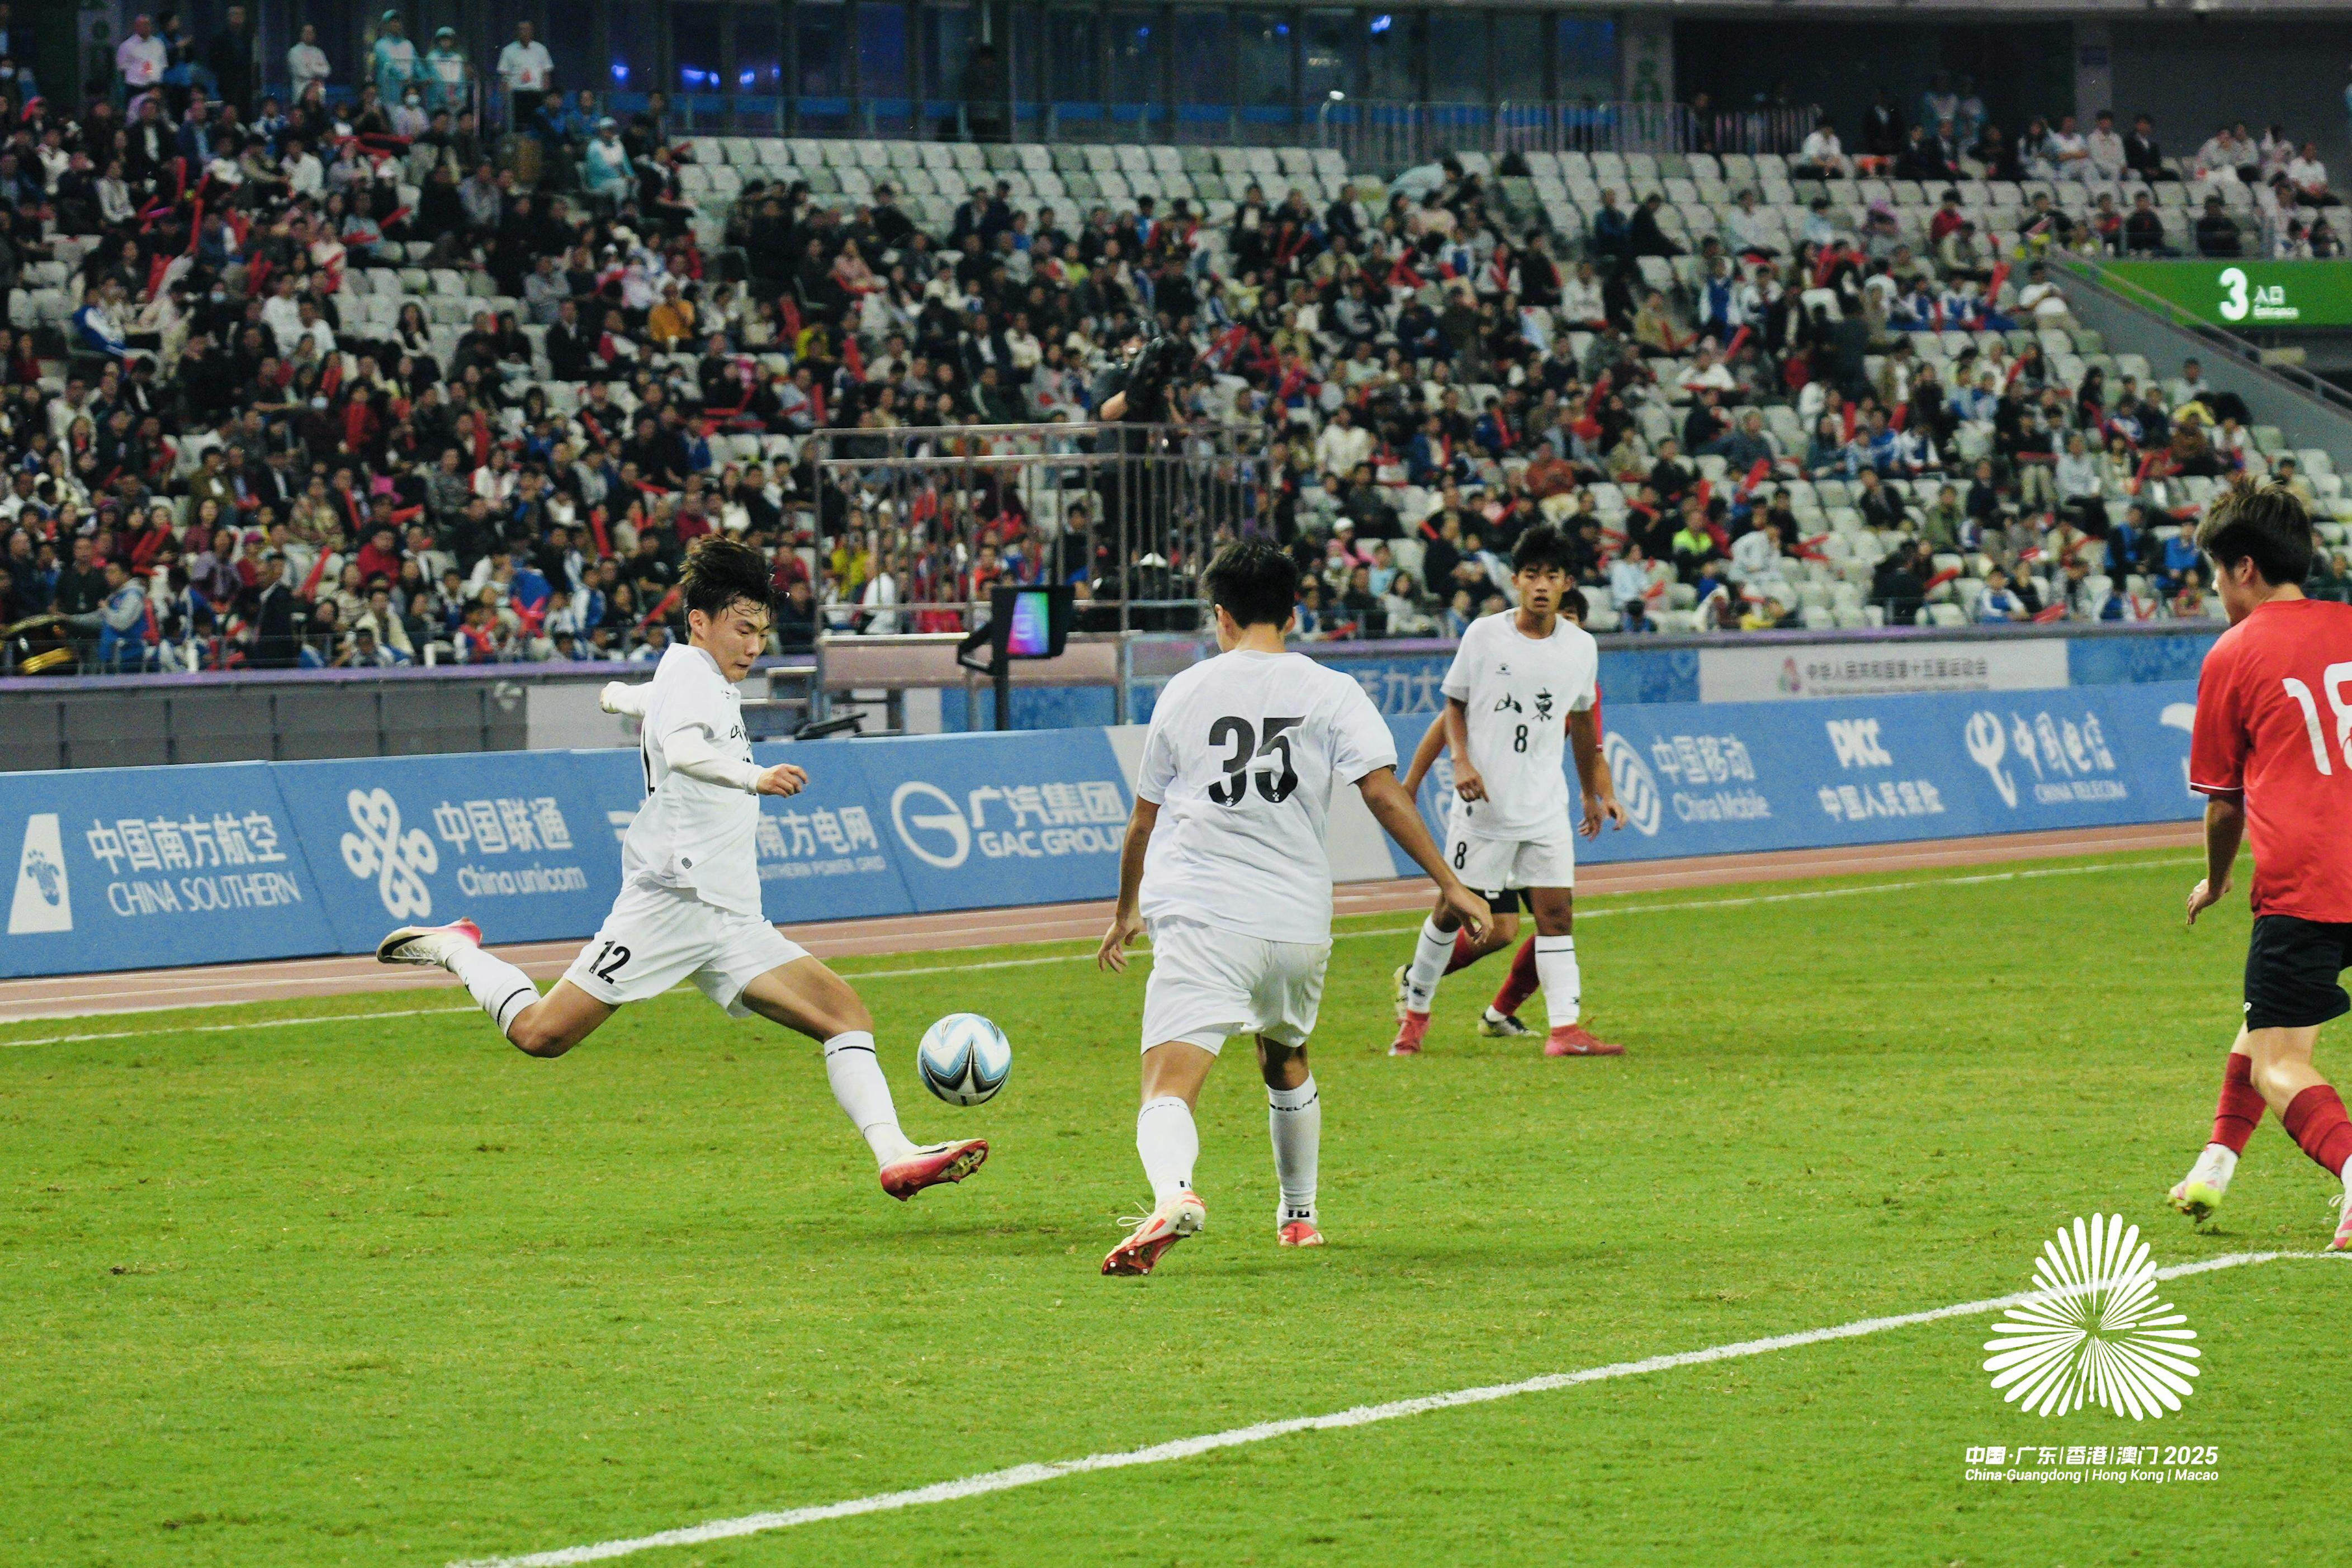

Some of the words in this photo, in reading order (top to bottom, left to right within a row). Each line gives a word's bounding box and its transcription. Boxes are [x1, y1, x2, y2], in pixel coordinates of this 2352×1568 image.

[2219, 267, 2249, 321] 3
[2254, 285, 2285, 305] 入口
[1208, 715, 1306, 807] 35
[1514, 724, 1528, 753] 8
[1651, 734, 1756, 784] 中国移动
[1825, 718, 1893, 768] PICC
[2012, 711, 2117, 781] 中国电信
[433, 797, 574, 855] 中国联通
[969, 781, 1127, 829] 广汽集团
[1672, 792, 1722, 822] China
[1715, 787, 1772, 819] Mobile
[87, 811, 286, 874] 中国南方航空
[756, 806, 879, 858] 南方电网
[978, 831, 1044, 858] GAC
[1454, 841, 1467, 870] 8
[107, 879, 183, 917] CHINA
[180, 872, 302, 911] SOUTHERN
[457, 864, 517, 897] China
[589, 940, 631, 984] 12
